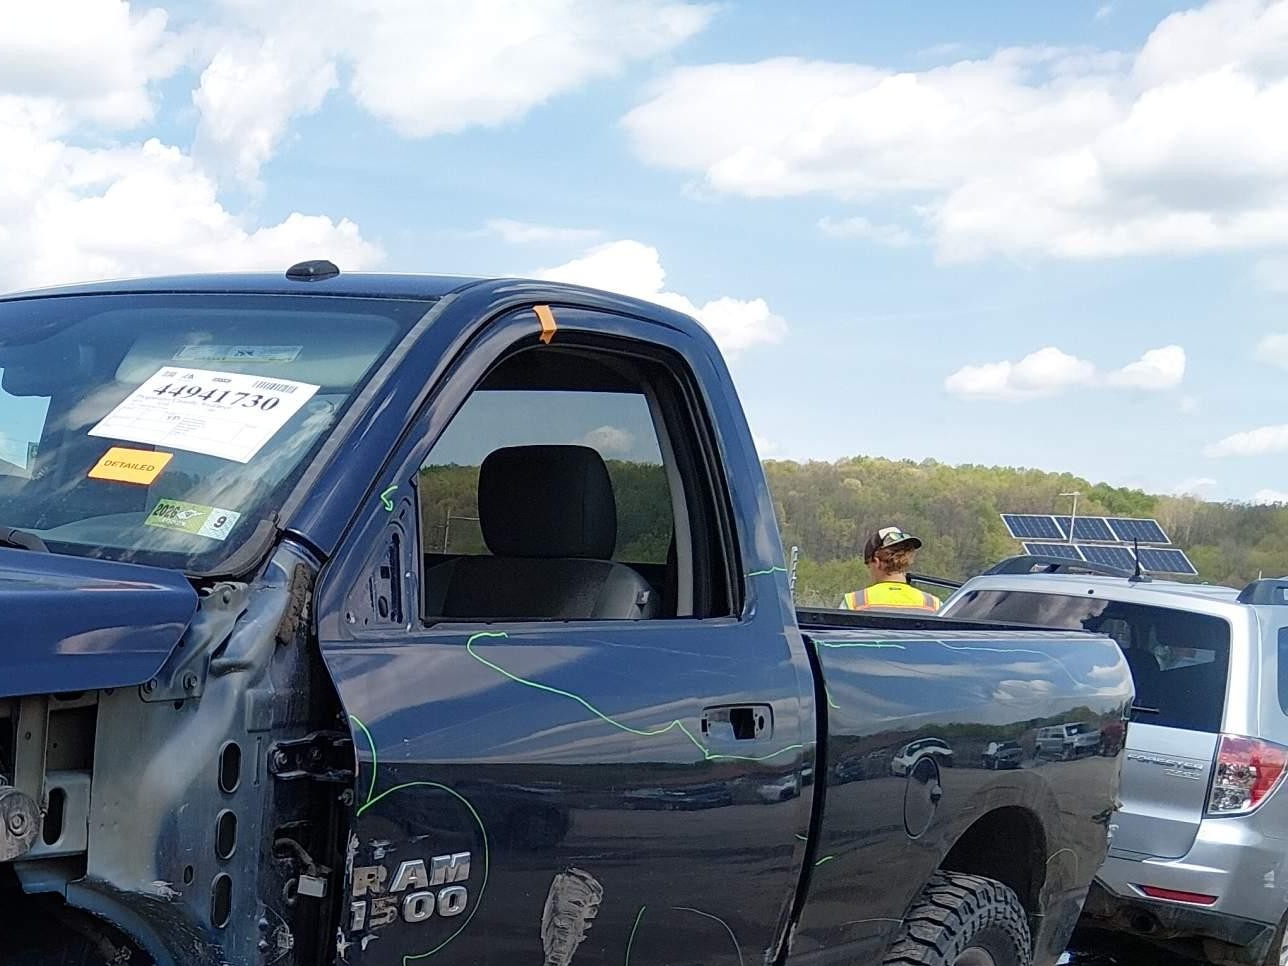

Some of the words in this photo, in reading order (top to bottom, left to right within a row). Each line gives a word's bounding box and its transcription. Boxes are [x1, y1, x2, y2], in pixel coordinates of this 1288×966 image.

[153, 383, 280, 411] 44941730
[103, 460, 155, 472] DETAILED
[213, 515, 227, 528] 9
[352, 851, 471, 897] RAM
[350, 885, 468, 932] 1500
